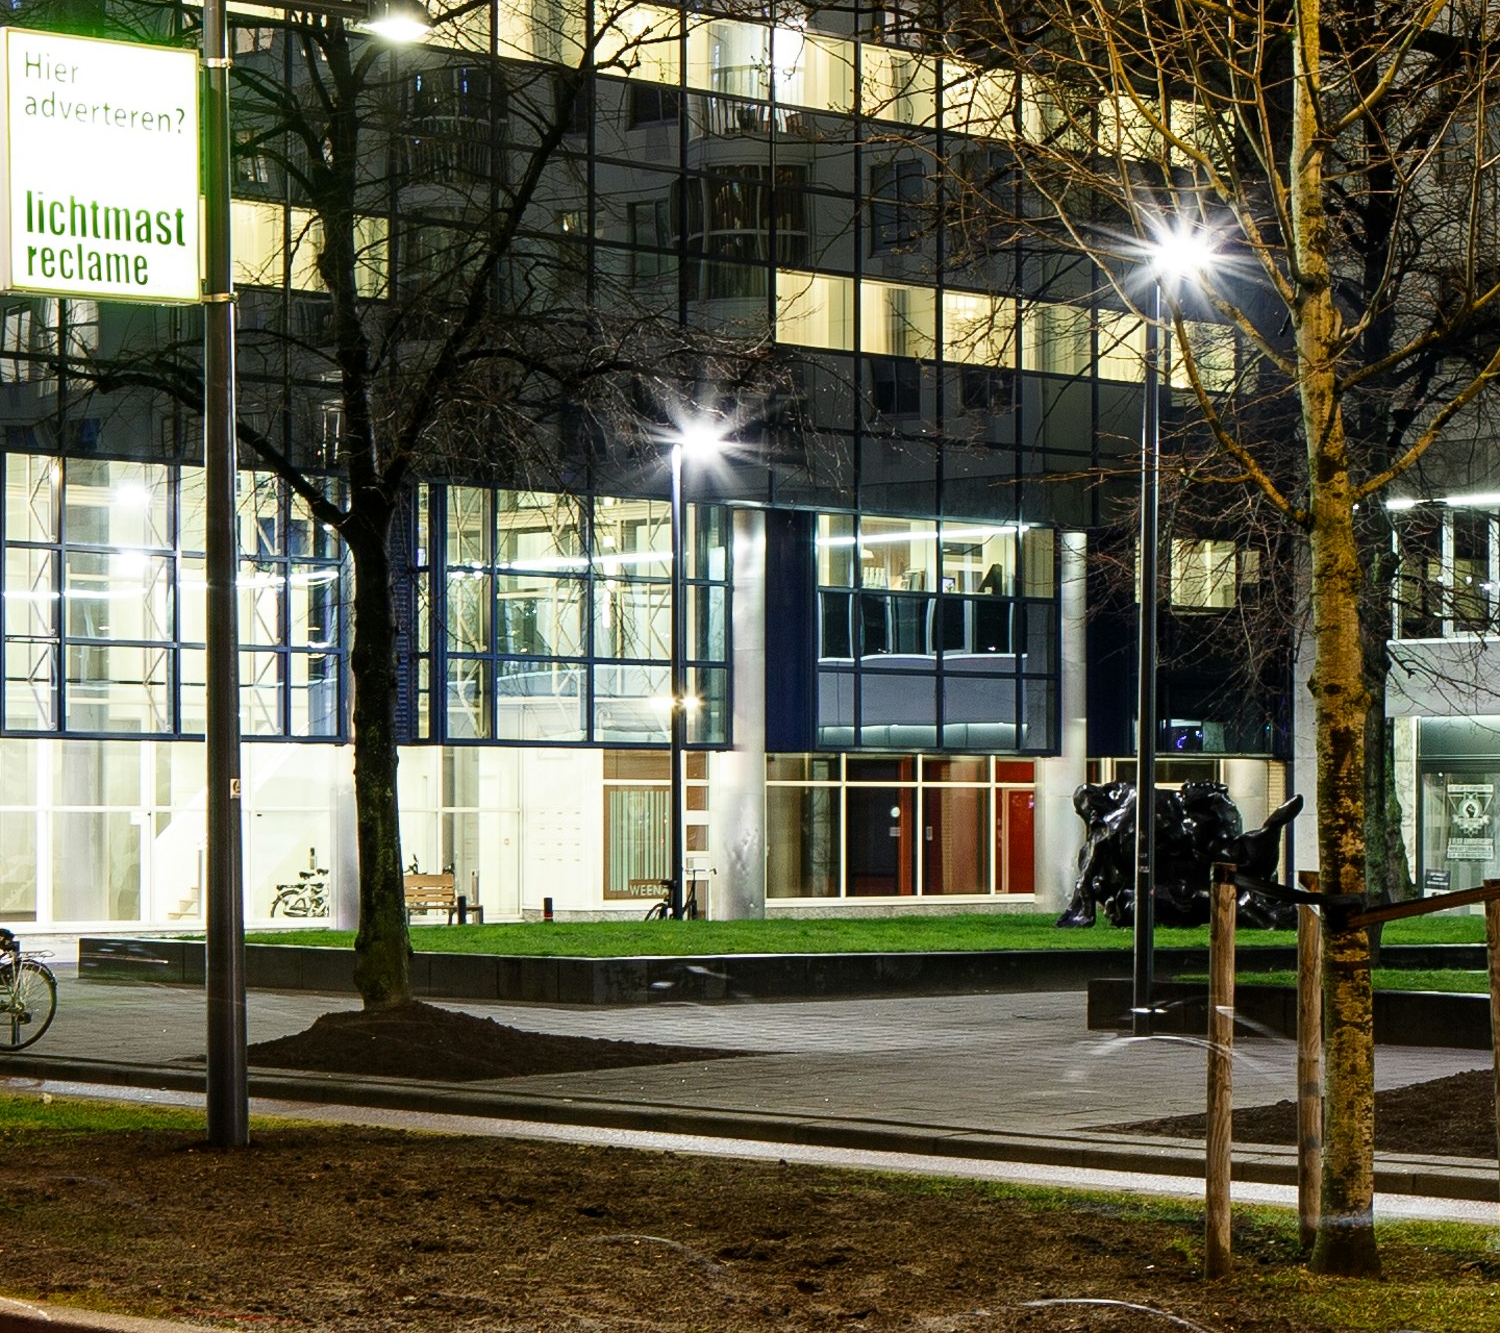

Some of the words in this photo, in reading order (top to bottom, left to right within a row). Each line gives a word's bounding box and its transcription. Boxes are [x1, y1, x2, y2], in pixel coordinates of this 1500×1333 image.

[24, 51, 80, 84] Hier
[24, 91, 186, 134] adverteren?
[26, 190, 187, 247] lichtmast
[27, 243, 150, 286] reclame
